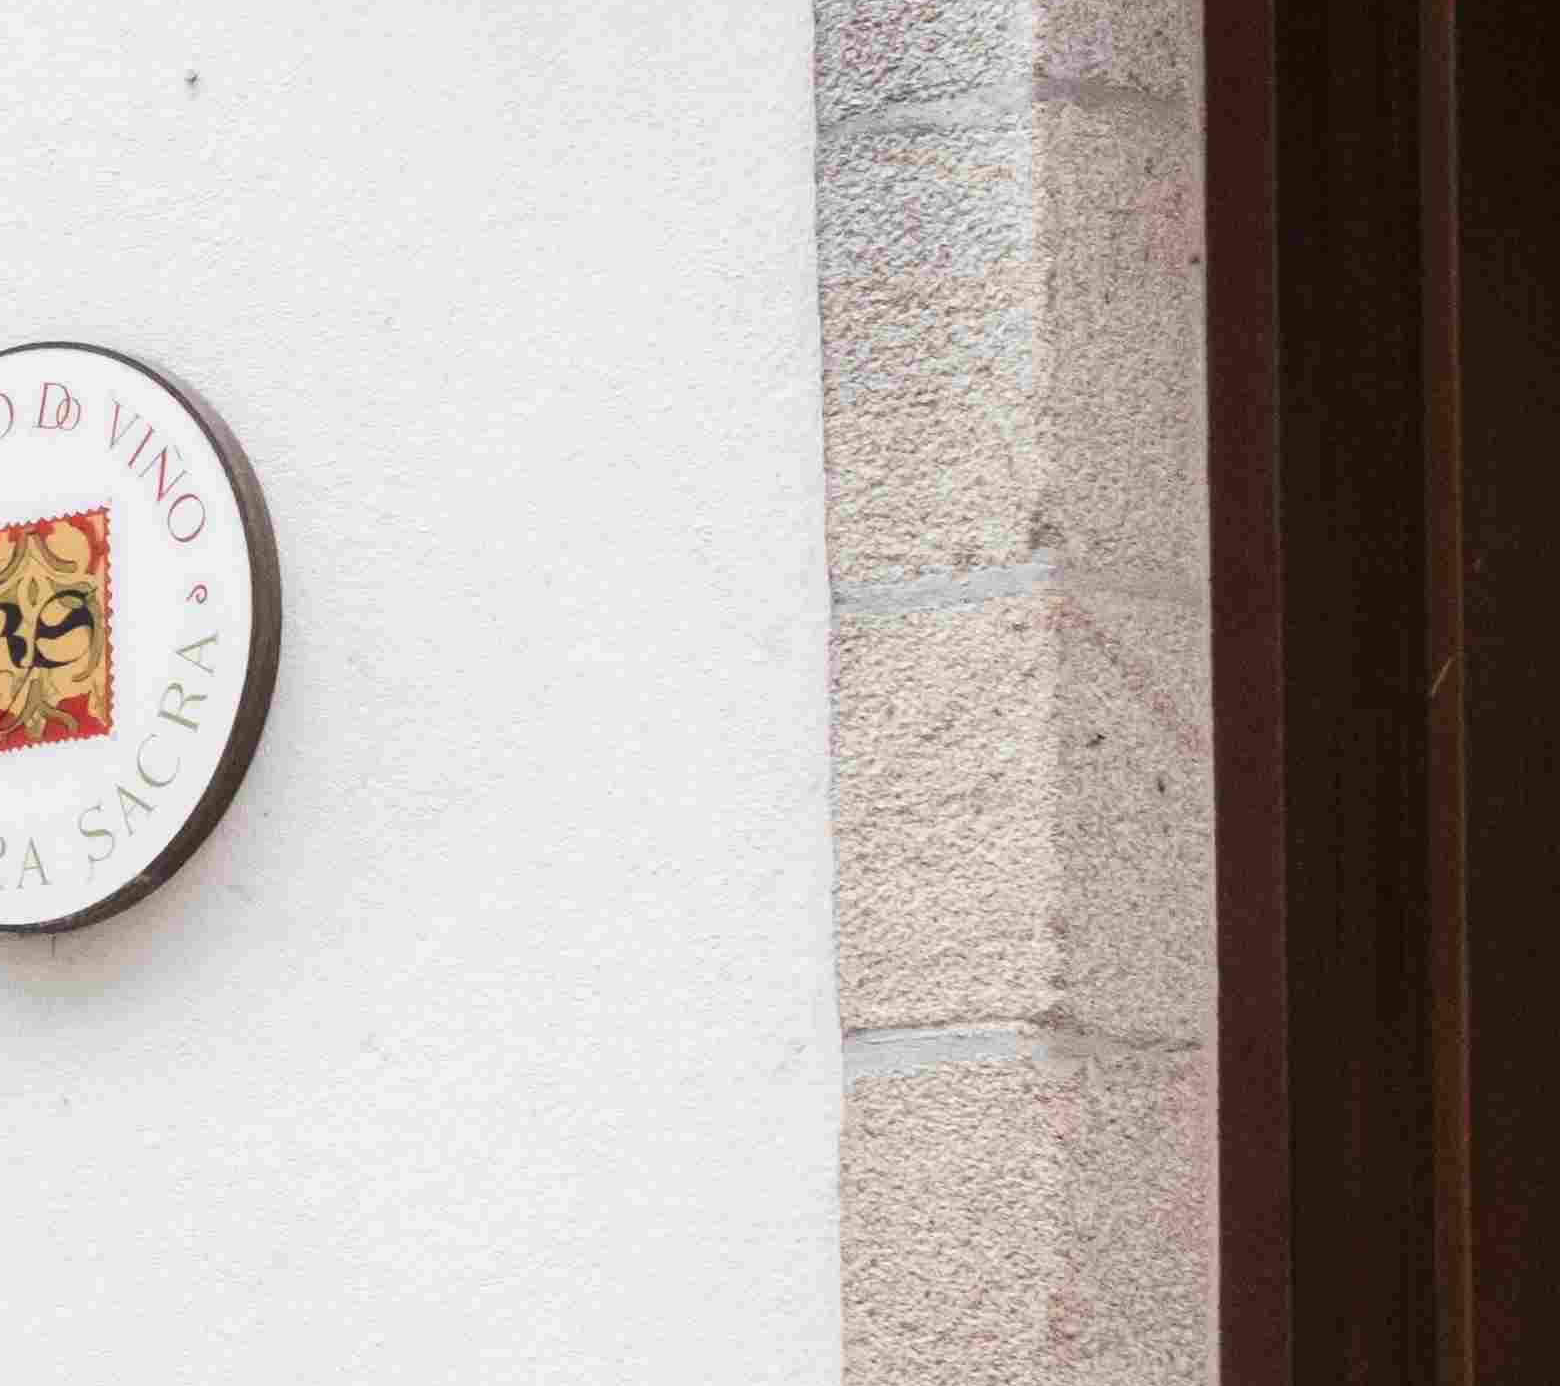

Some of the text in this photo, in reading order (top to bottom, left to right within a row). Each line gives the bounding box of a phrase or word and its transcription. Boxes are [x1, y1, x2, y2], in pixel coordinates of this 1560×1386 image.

[35, 380, 81, 434] DO
[107, 399, 207, 544] VIÑO
[77, 629, 220, 864] SACRA
